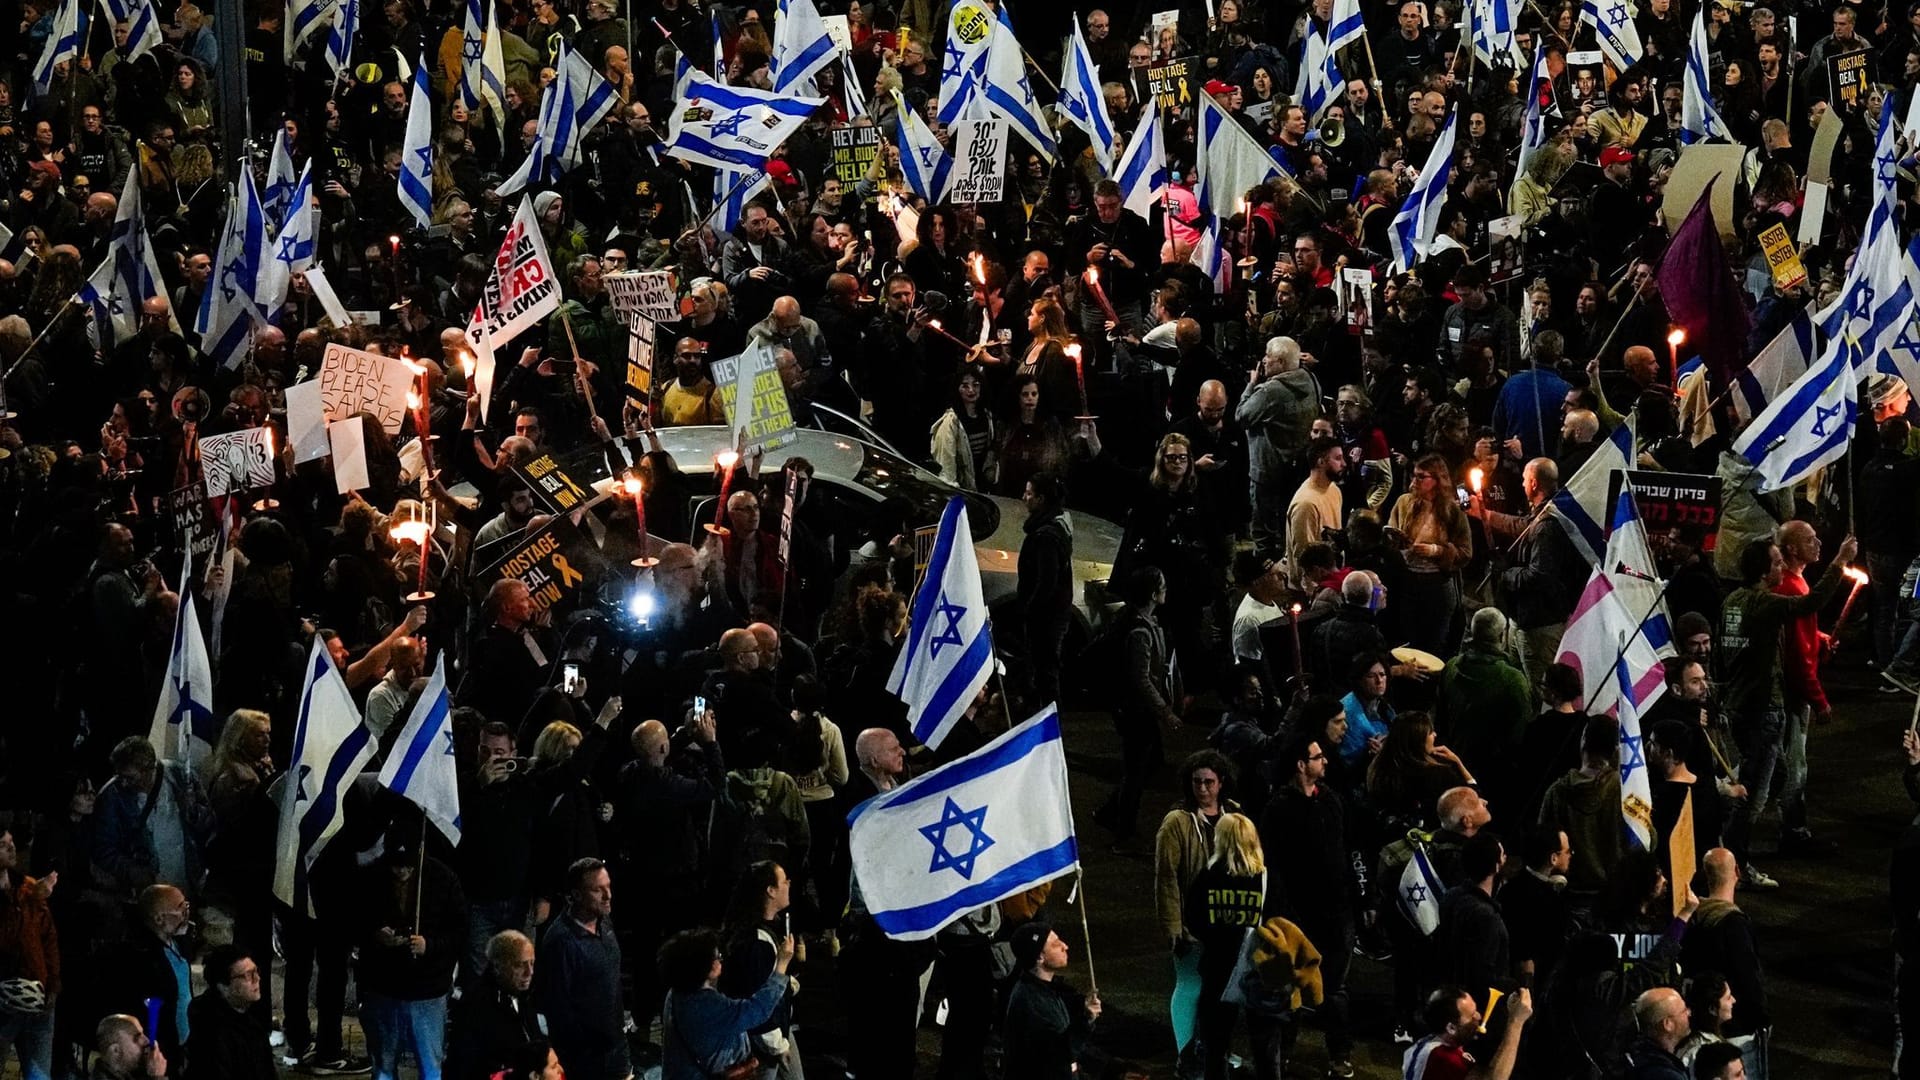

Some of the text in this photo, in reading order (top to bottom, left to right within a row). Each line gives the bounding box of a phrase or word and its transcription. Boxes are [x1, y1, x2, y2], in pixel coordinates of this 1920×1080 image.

[1837, 53, 1867, 72] HOSTAGE
[1839, 70, 1857, 86] DEAL
[1156, 93, 1176, 109] NW
[832, 127, 855, 148] HEY
[974, 121, 996, 139] יחד
[855, 146, 878, 161] BIDE
[969, 157, 996, 182] אותך
[1762, 227, 1787, 249] SISTER
[1769, 244, 1795, 267] SISTER
[325, 348, 385, 383] BIDEN
[321, 369, 392, 409] PLEASE
[321, 391, 373, 417] SAVE
[524, 454, 559, 479] HOSTAGE
[538, 473, 564, 494] DEAL
[1674, 487, 1707, 501] פדיון
[175, 484, 204, 509] WAR
[553, 488, 579, 510] NOW
[175, 503, 204, 529] HAS
[500, 531, 561, 580] HOSTAGE
[519, 566, 551, 592] EAL
[1208, 888, 1263, 908] הדחה
[1208, 908, 1260, 926] עכשיו
